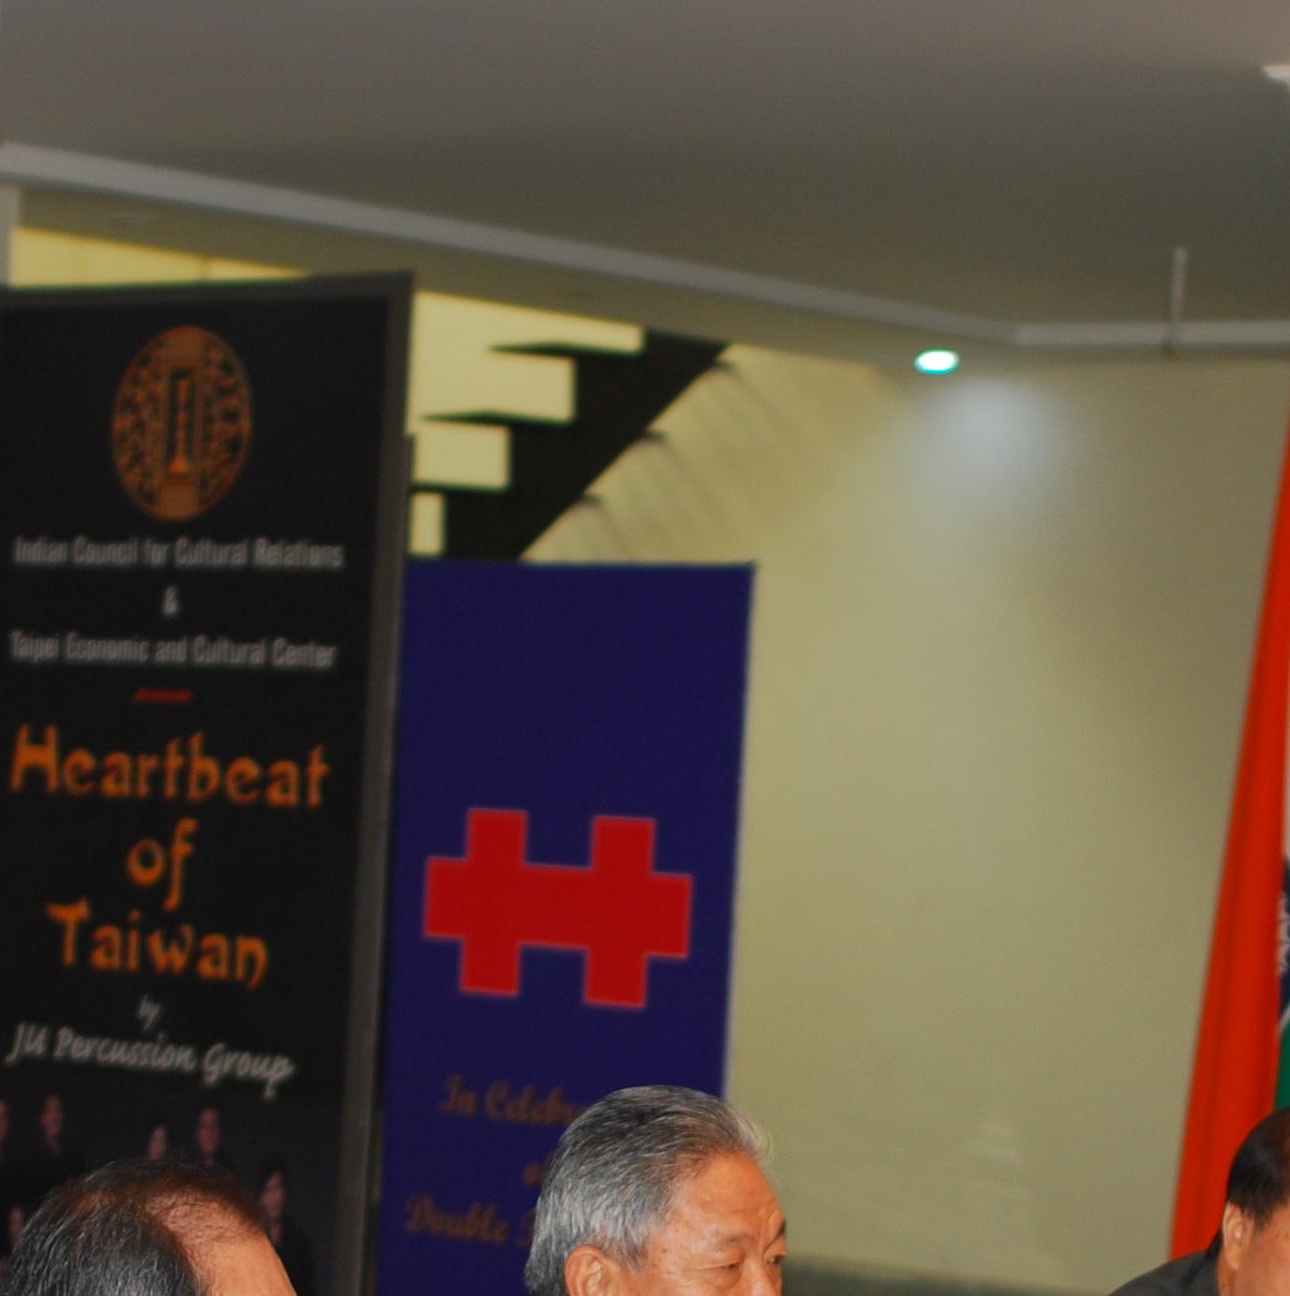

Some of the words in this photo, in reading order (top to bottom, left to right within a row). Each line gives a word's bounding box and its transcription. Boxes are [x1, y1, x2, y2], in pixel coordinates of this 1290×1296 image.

[13, 537, 68, 566] Indian
[72, 536, 139, 566] Council
[144, 539, 171, 566] for
[174, 536, 248, 568] Cultural
[253, 537, 344, 570] Relations
[162, 585, 180, 617] &
[10, 630, 59, 663] Taipei
[65, 632, 150, 664] Economic
[154, 637, 188, 664] and
[193, 635, 266, 667] Cultural
[271, 638, 337, 669] Center
[10, 724, 331, 808] Heartbeat
[126, 817, 197, 911] of
[46, 898, 268, 989] Taiwan
[53, 1028, 197, 1072] Percussion
[201, 1043, 296, 1099] Group
